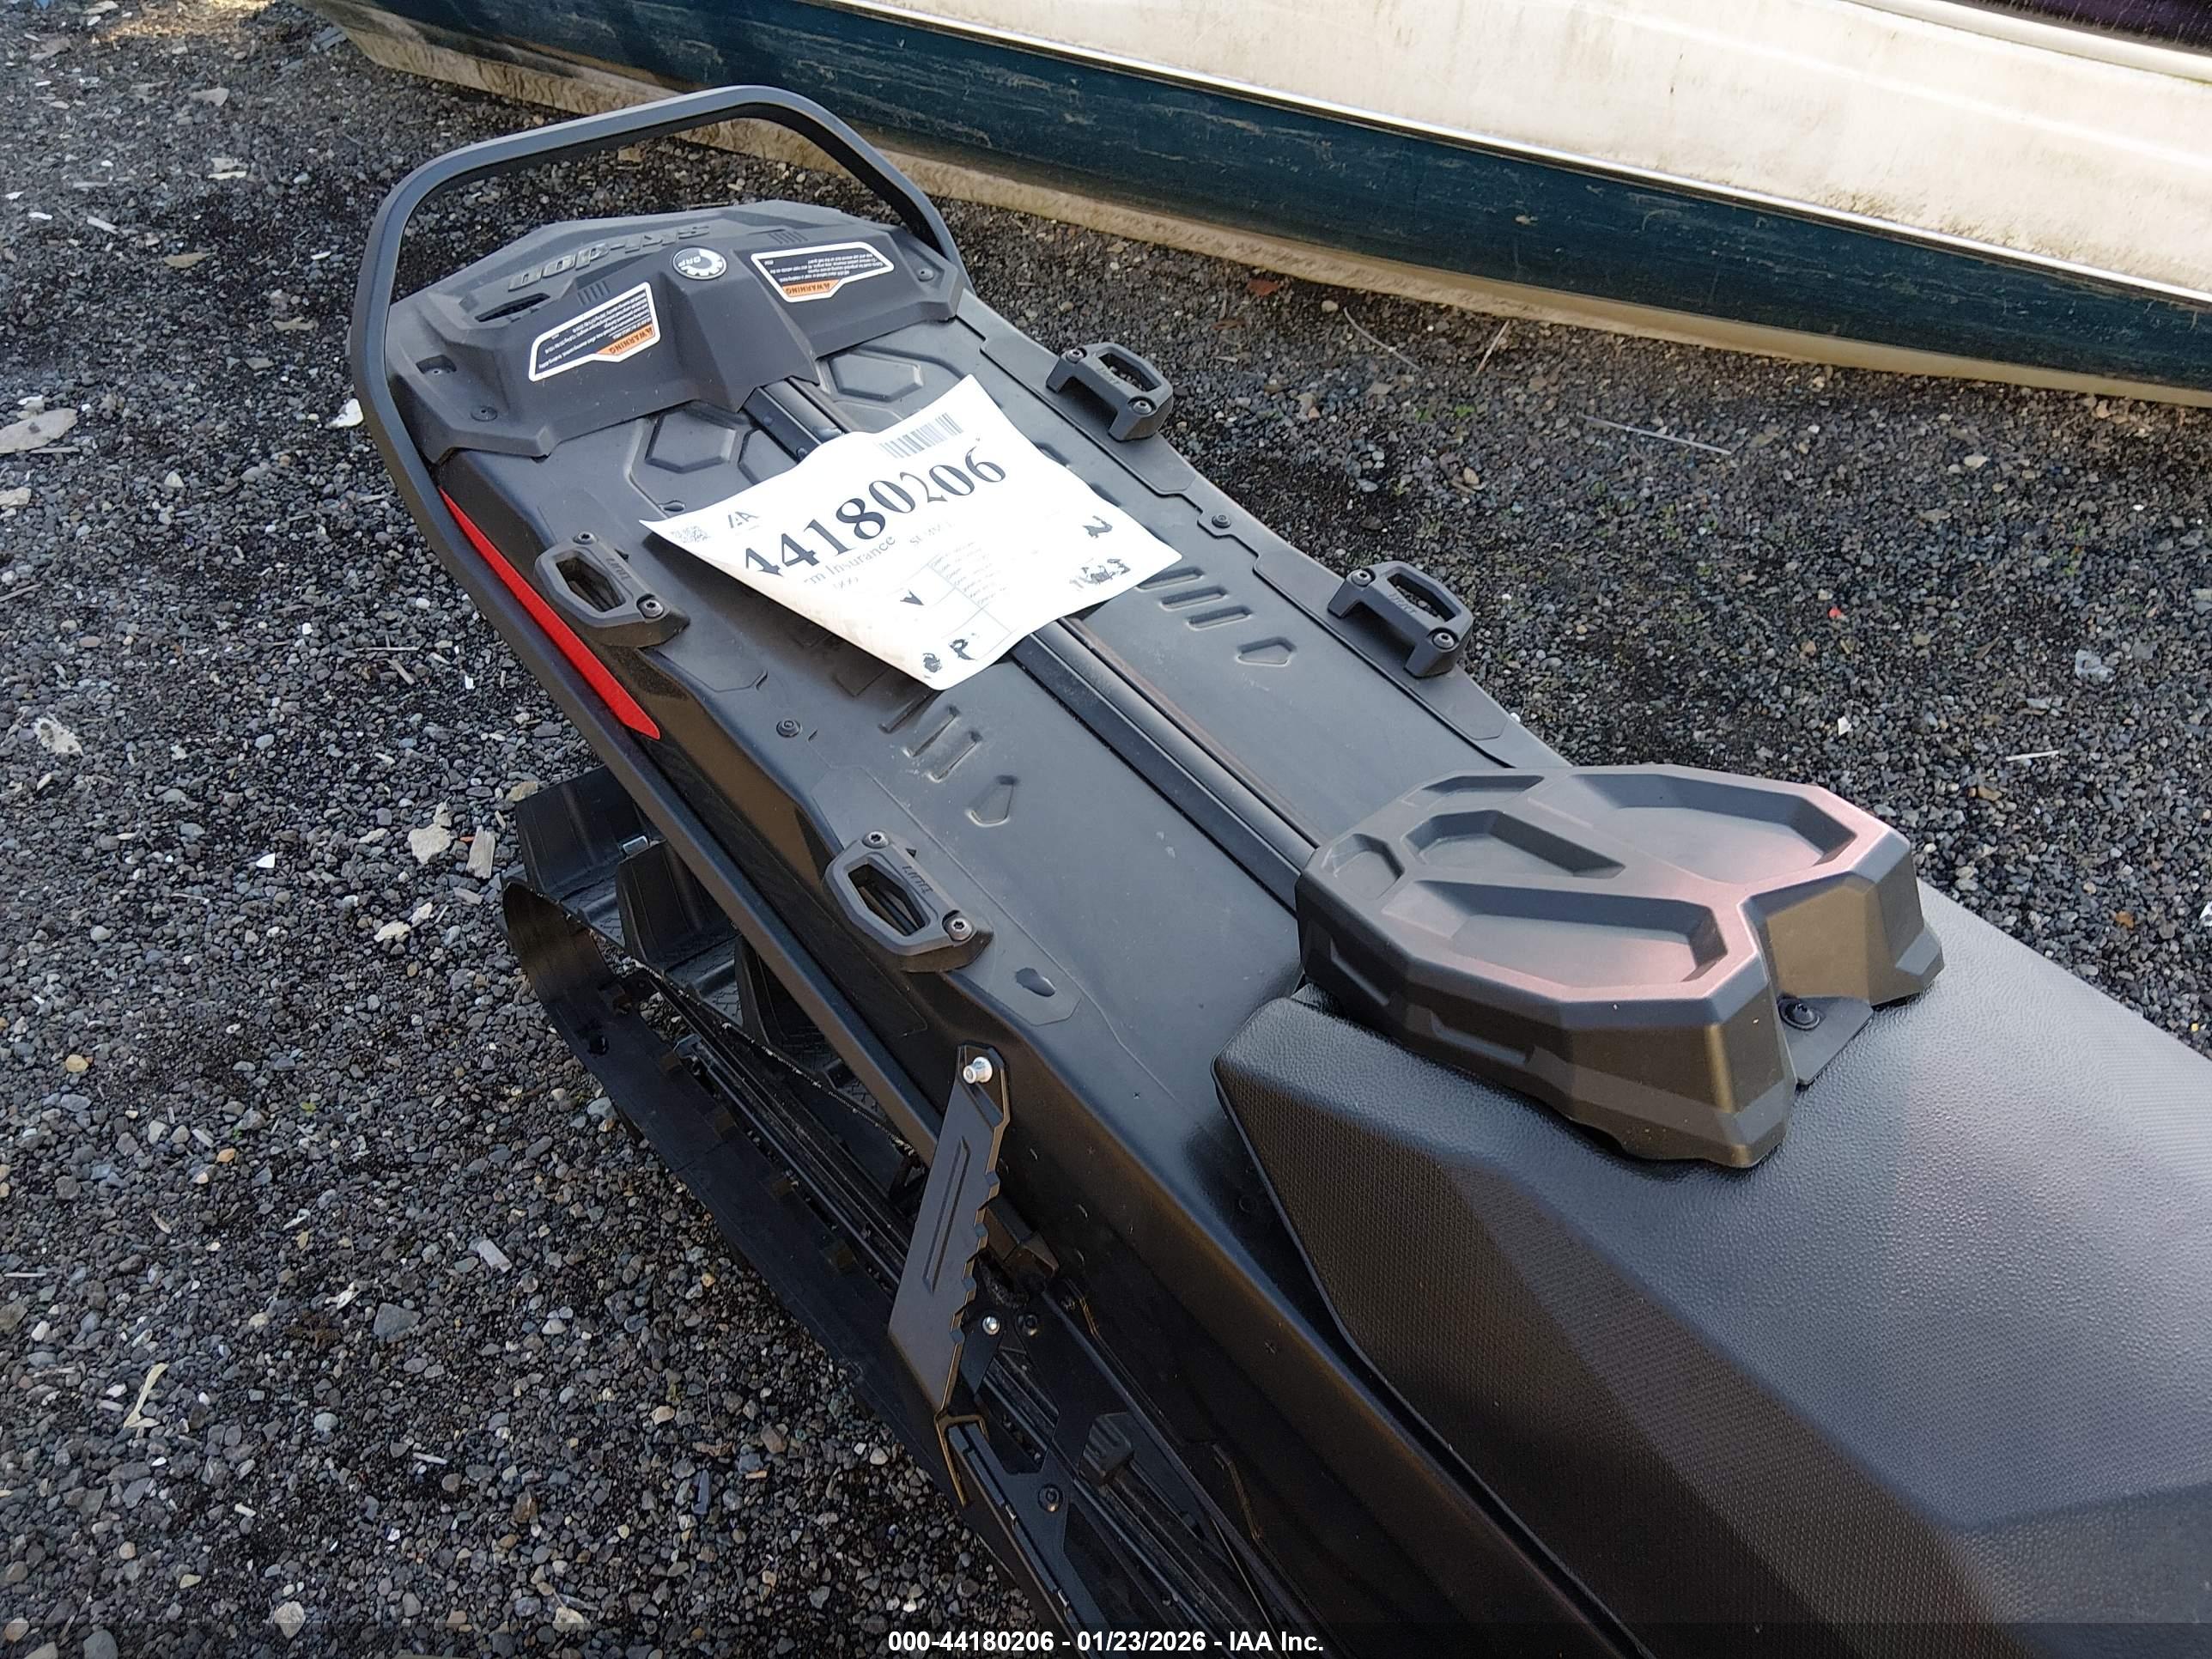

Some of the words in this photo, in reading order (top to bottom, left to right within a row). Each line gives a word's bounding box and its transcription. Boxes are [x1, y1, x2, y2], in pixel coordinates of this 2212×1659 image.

[786, 283, 823, 295] WARNING
[609, 331, 647, 355] WARNING
[745, 446, 1006, 578] 44180206
[824, 536, 896, 575] Insurance
